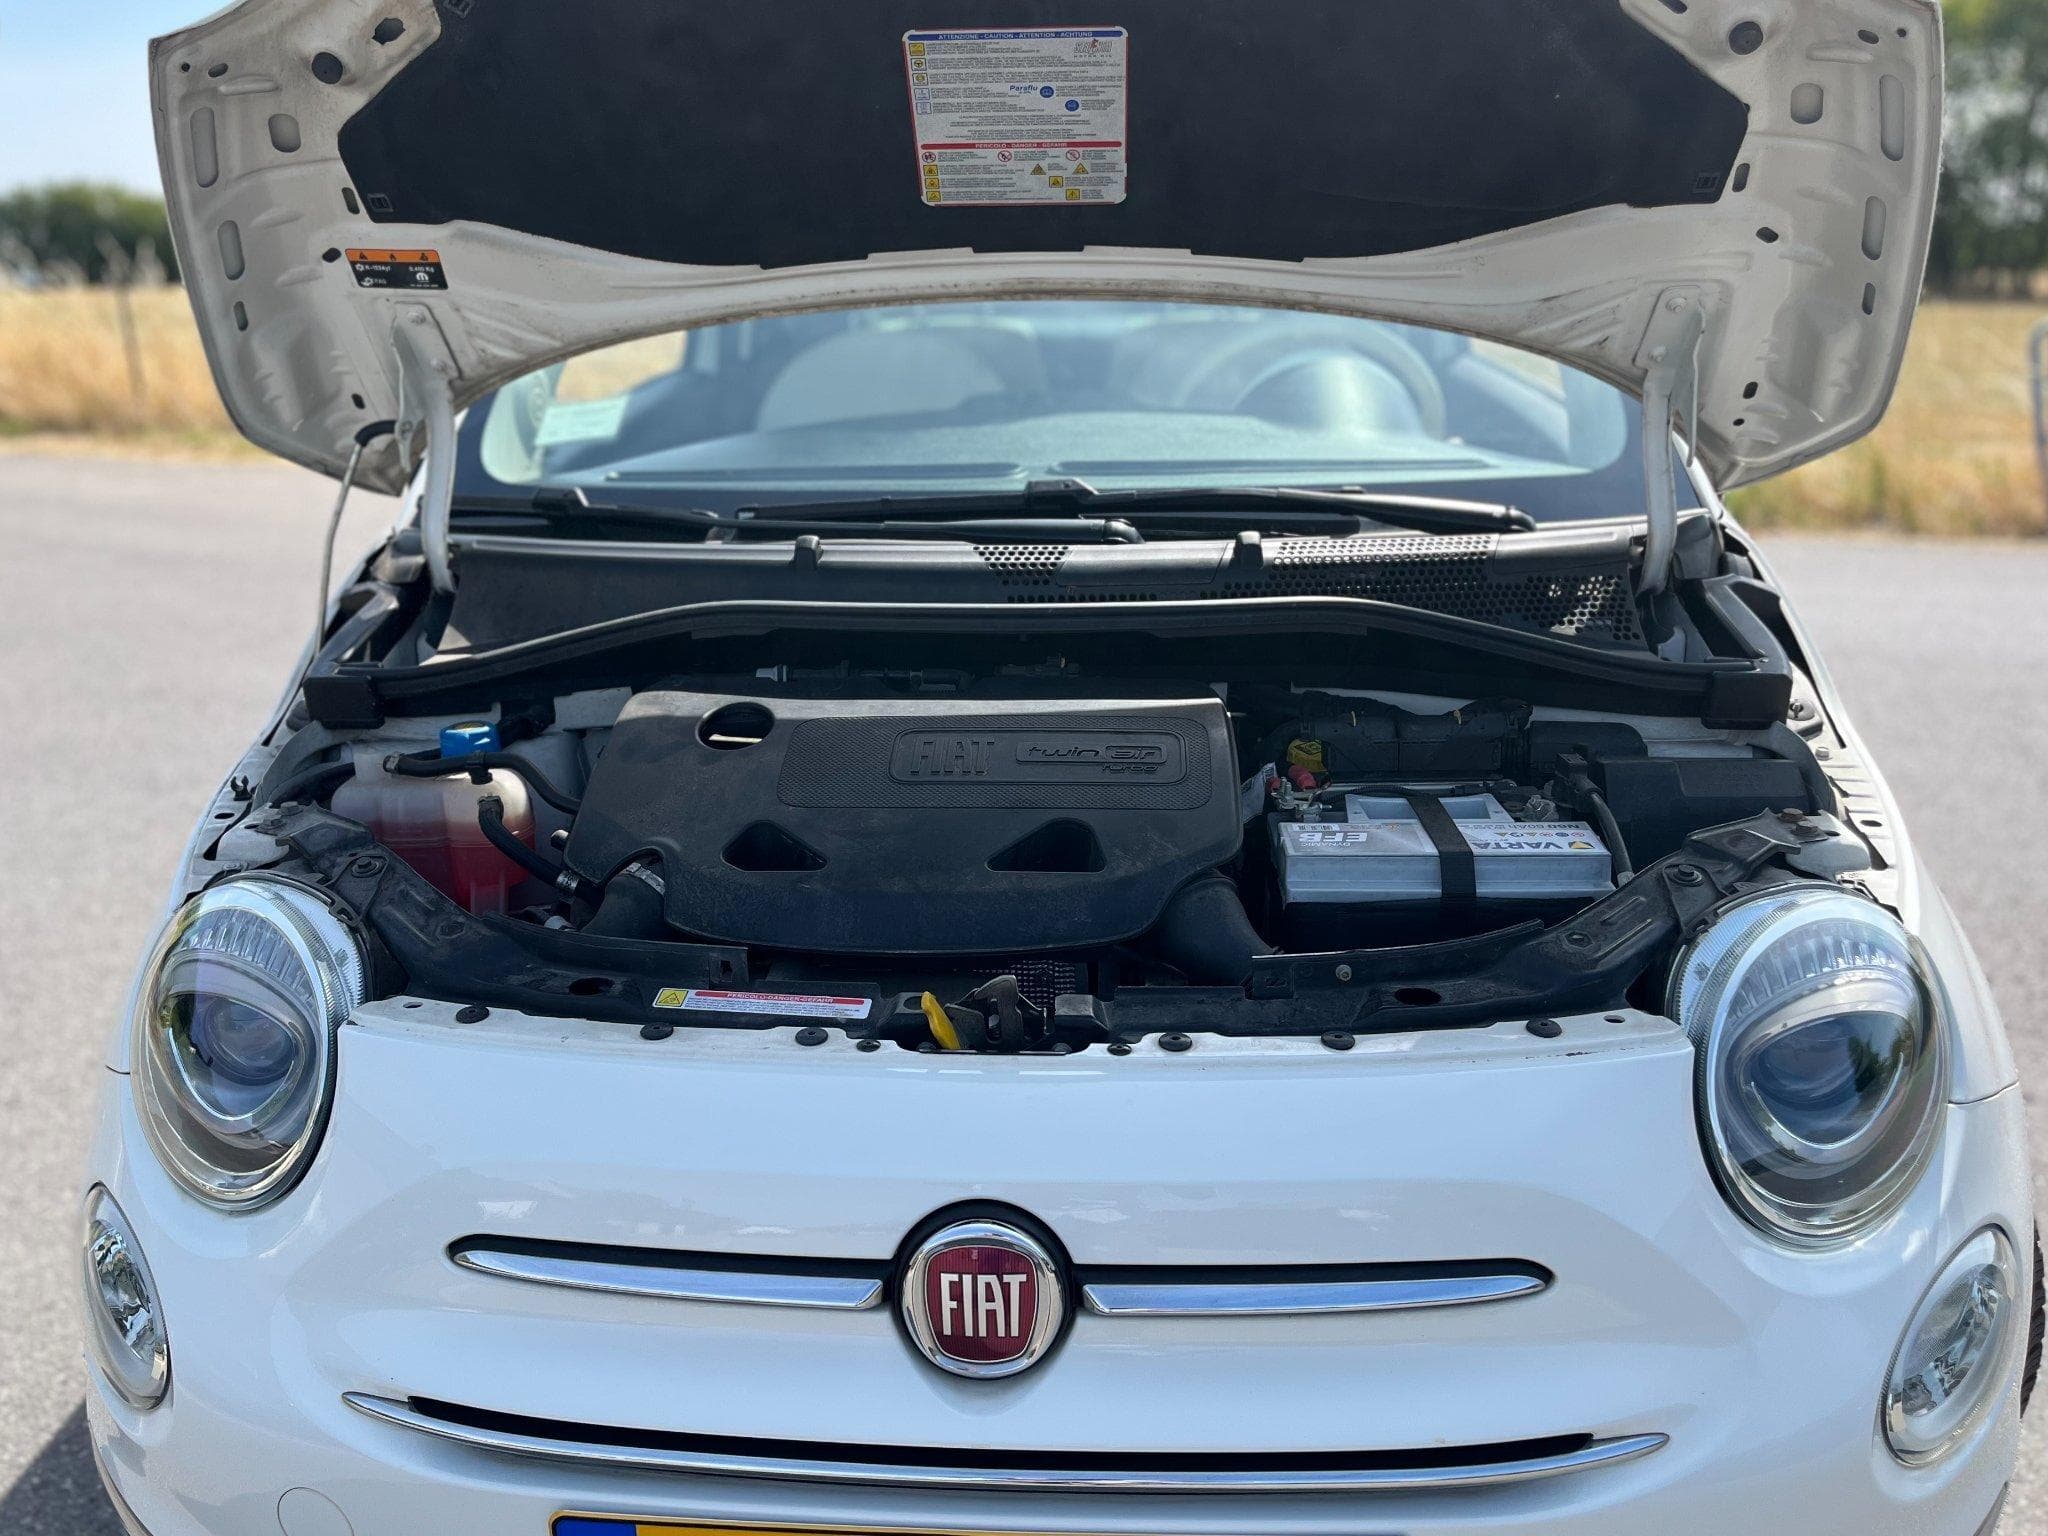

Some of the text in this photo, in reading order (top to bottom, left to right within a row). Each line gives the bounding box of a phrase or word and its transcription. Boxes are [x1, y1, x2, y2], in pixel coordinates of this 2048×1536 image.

[909, 738, 995, 775] FIAT
[1027, 746, 1101, 758] twin
[1299, 832, 1368, 842] EFB
[1471, 841, 1564, 850] VARTA
[940, 1273, 1027, 1337] FIAT
